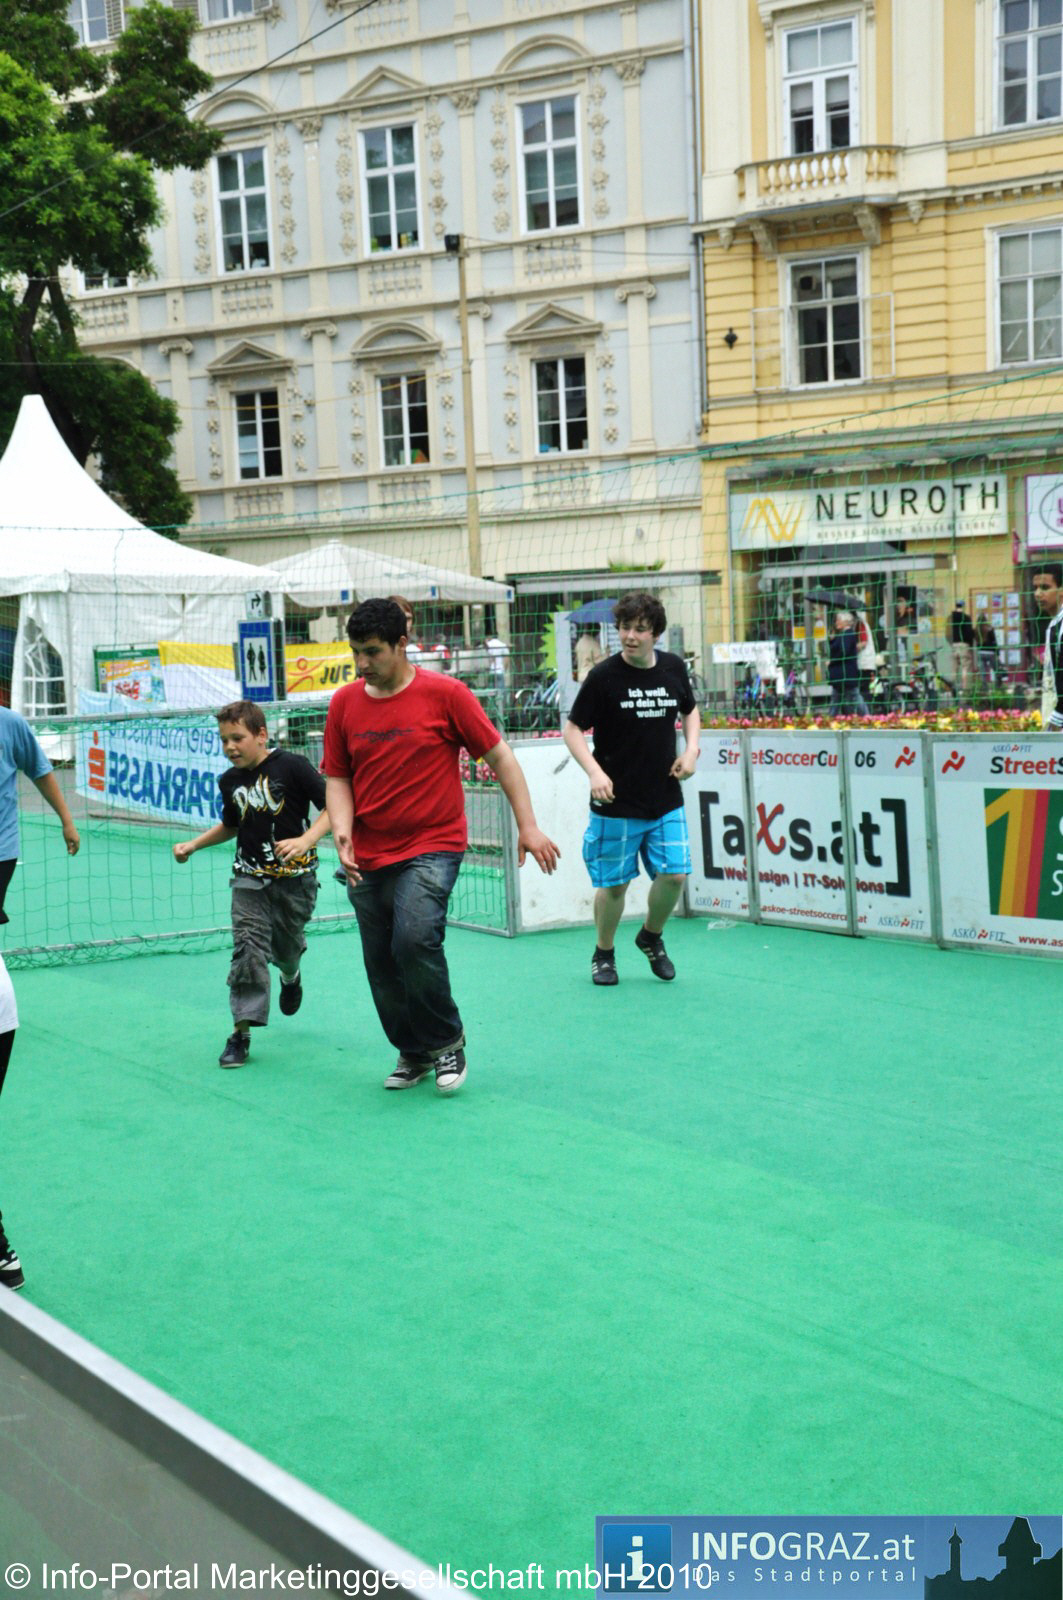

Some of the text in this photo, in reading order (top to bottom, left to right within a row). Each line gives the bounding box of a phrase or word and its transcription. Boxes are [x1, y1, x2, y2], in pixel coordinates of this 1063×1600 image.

[815, 481, 999, 521] NEUROTH
[319, 664, 356, 685] JUF
[854, 751, 877, 768] 06
